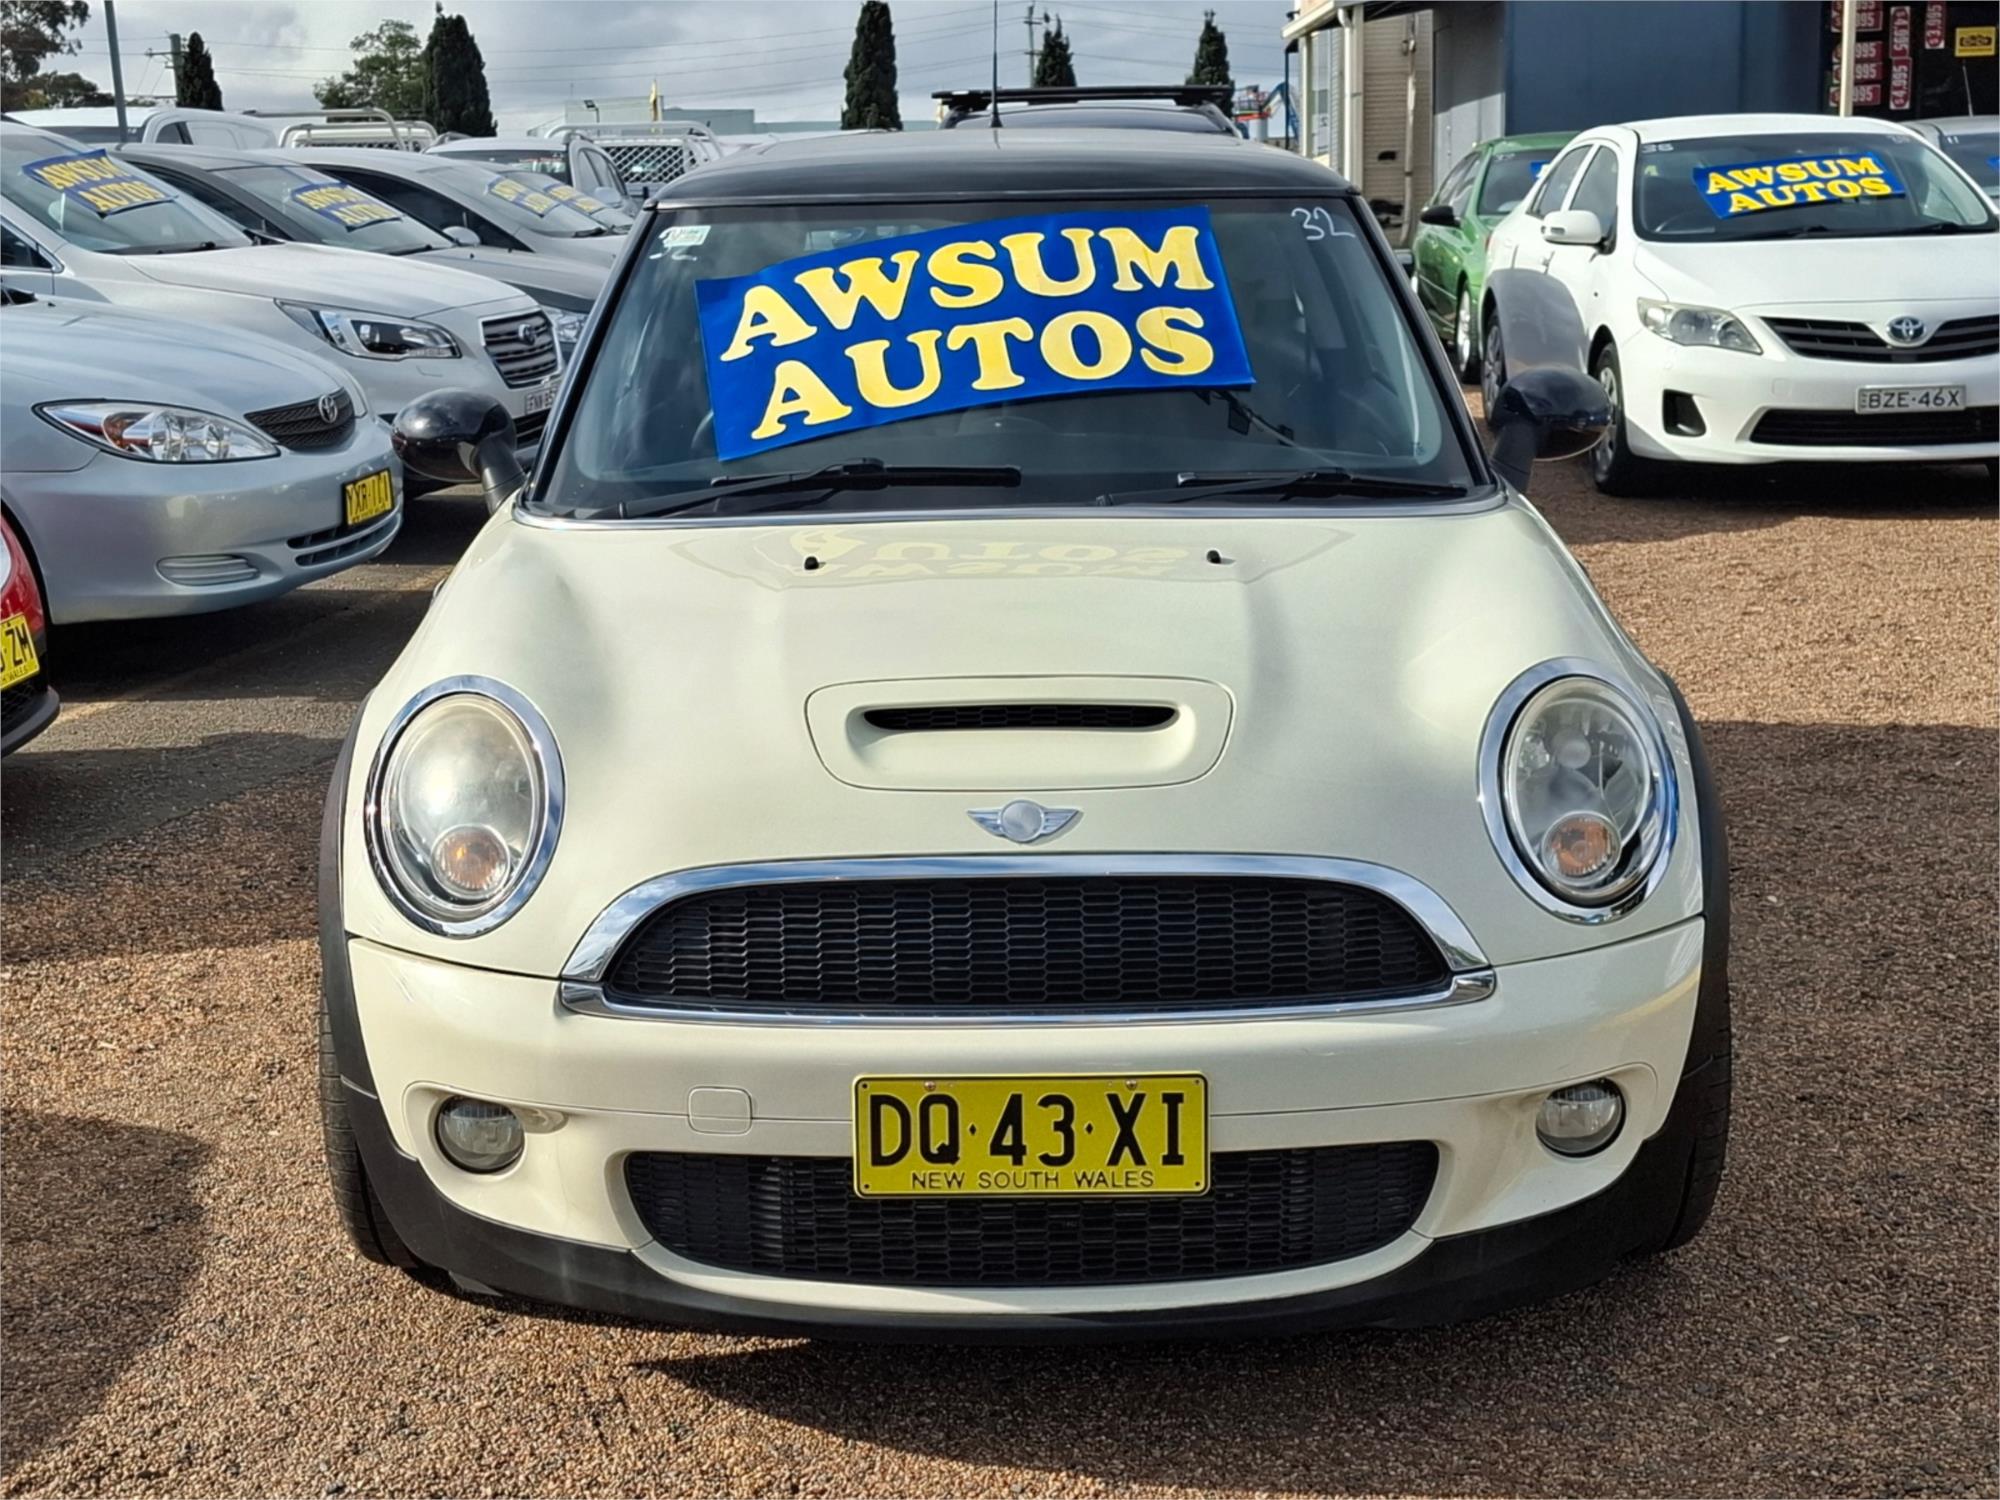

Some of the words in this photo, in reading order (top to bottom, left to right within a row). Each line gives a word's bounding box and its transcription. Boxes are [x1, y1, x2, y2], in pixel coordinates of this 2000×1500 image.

[1706, 157, 1884, 194] AWSUM
[1727, 177, 1892, 213] AUTOS
[1291, 207, 1356, 240] 32
[720, 226, 1214, 362] AWSUM
[751, 307, 1214, 440] AUTOS
[912, 1172, 965, 1189] NEW
[979, 1171, 1058, 1189] SOUTH
[1075, 1170, 1154, 1188] WALES
